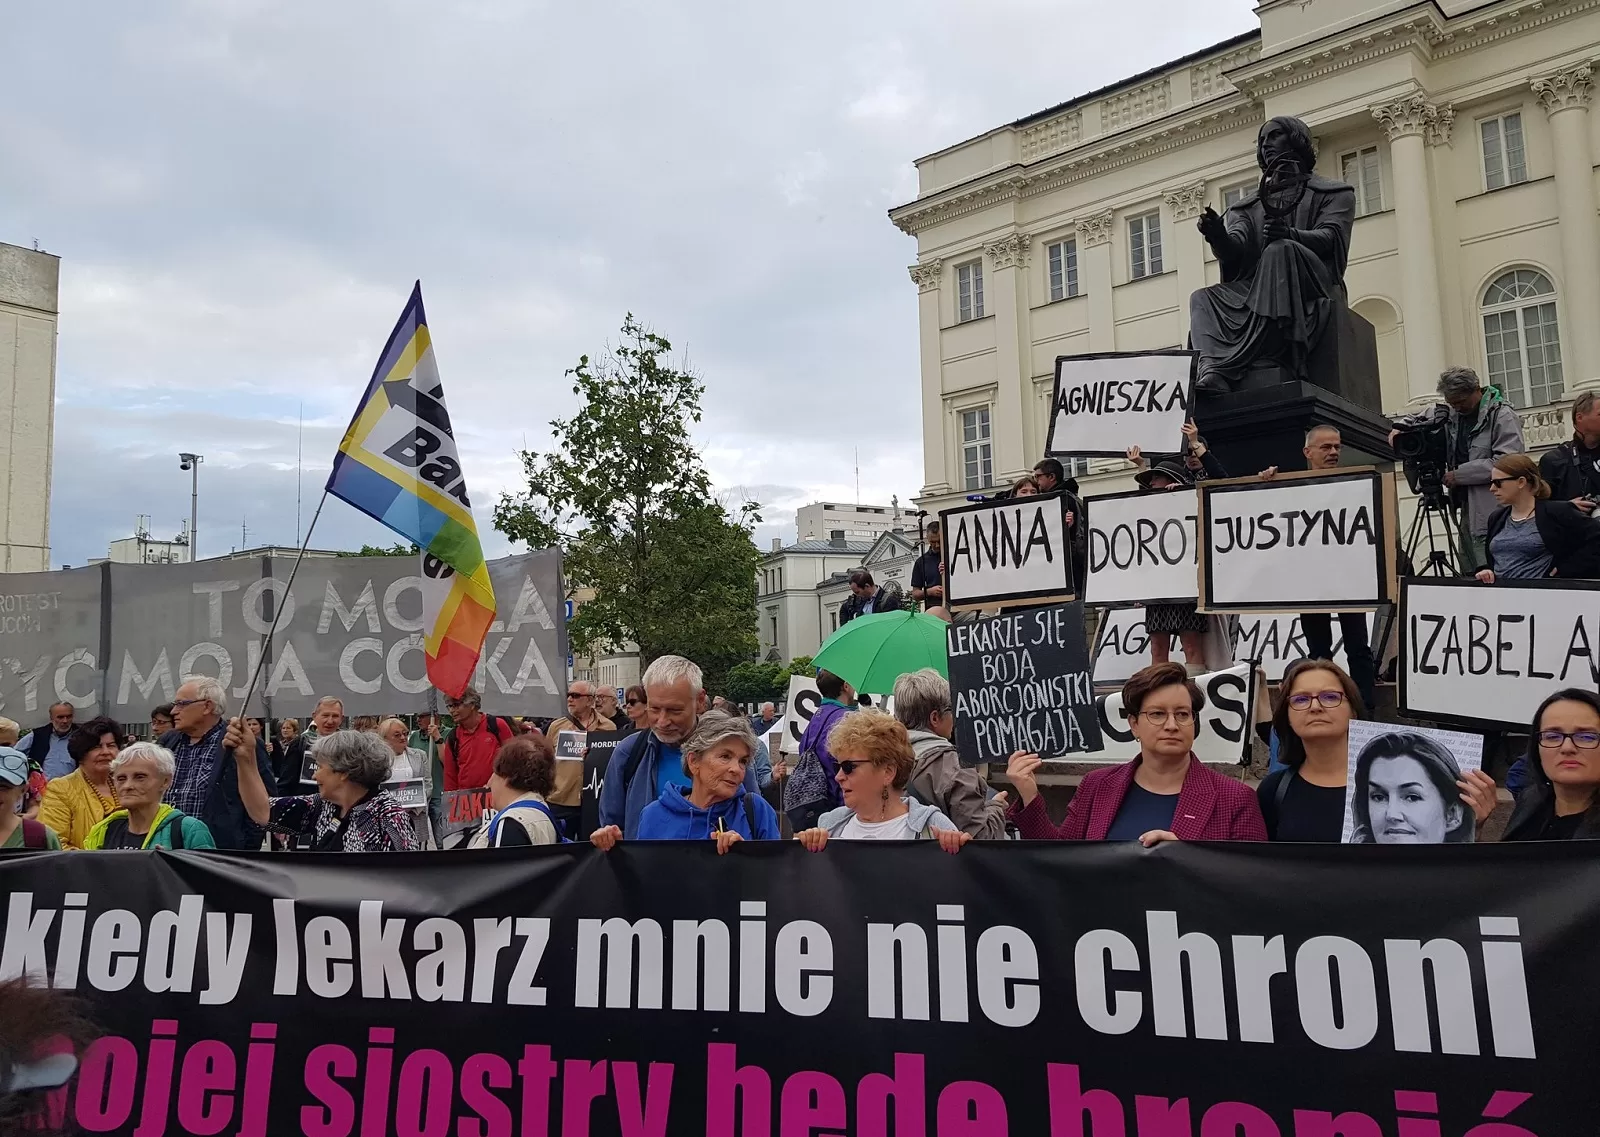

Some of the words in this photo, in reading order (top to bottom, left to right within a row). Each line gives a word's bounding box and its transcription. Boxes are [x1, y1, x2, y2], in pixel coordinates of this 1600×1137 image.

[1057, 379, 1188, 415] AGNIESZKA
[951, 506, 1053, 576] ANNA
[1090, 515, 1198, 574] DOROT
[1214, 505, 1377, 554] JUSTYNA
[0, 591, 61, 612] ROTEST
[192, 576, 296, 638] TO
[316, 573, 557, 634] MOA
[947, 615, 1025, 657] LEKARZE
[1031, 608, 1066, 649] SIĘ
[1411, 614, 1600, 684] IZABELA
[0, 647, 97, 712] YĆ
[116, 639, 315, 705] MOJA
[338, 633, 560, 695] CÓKA
[981, 648, 1037, 685] BOJĄ
[955, 671, 1092, 719] ABORCJONISTKI
[974, 708, 1089, 759] POMAGAJĄ
[0, 891, 254, 1006] kiedy
[274, 898, 552, 1005] lekarz
[575, 901, 834, 1017] mnie
[867, 904, 1041, 1028] nie
[1074, 910, 1537, 1060] chroni
[22, 1018, 279, 1137] ojej
[300, 1026, 675, 1137] siostry
